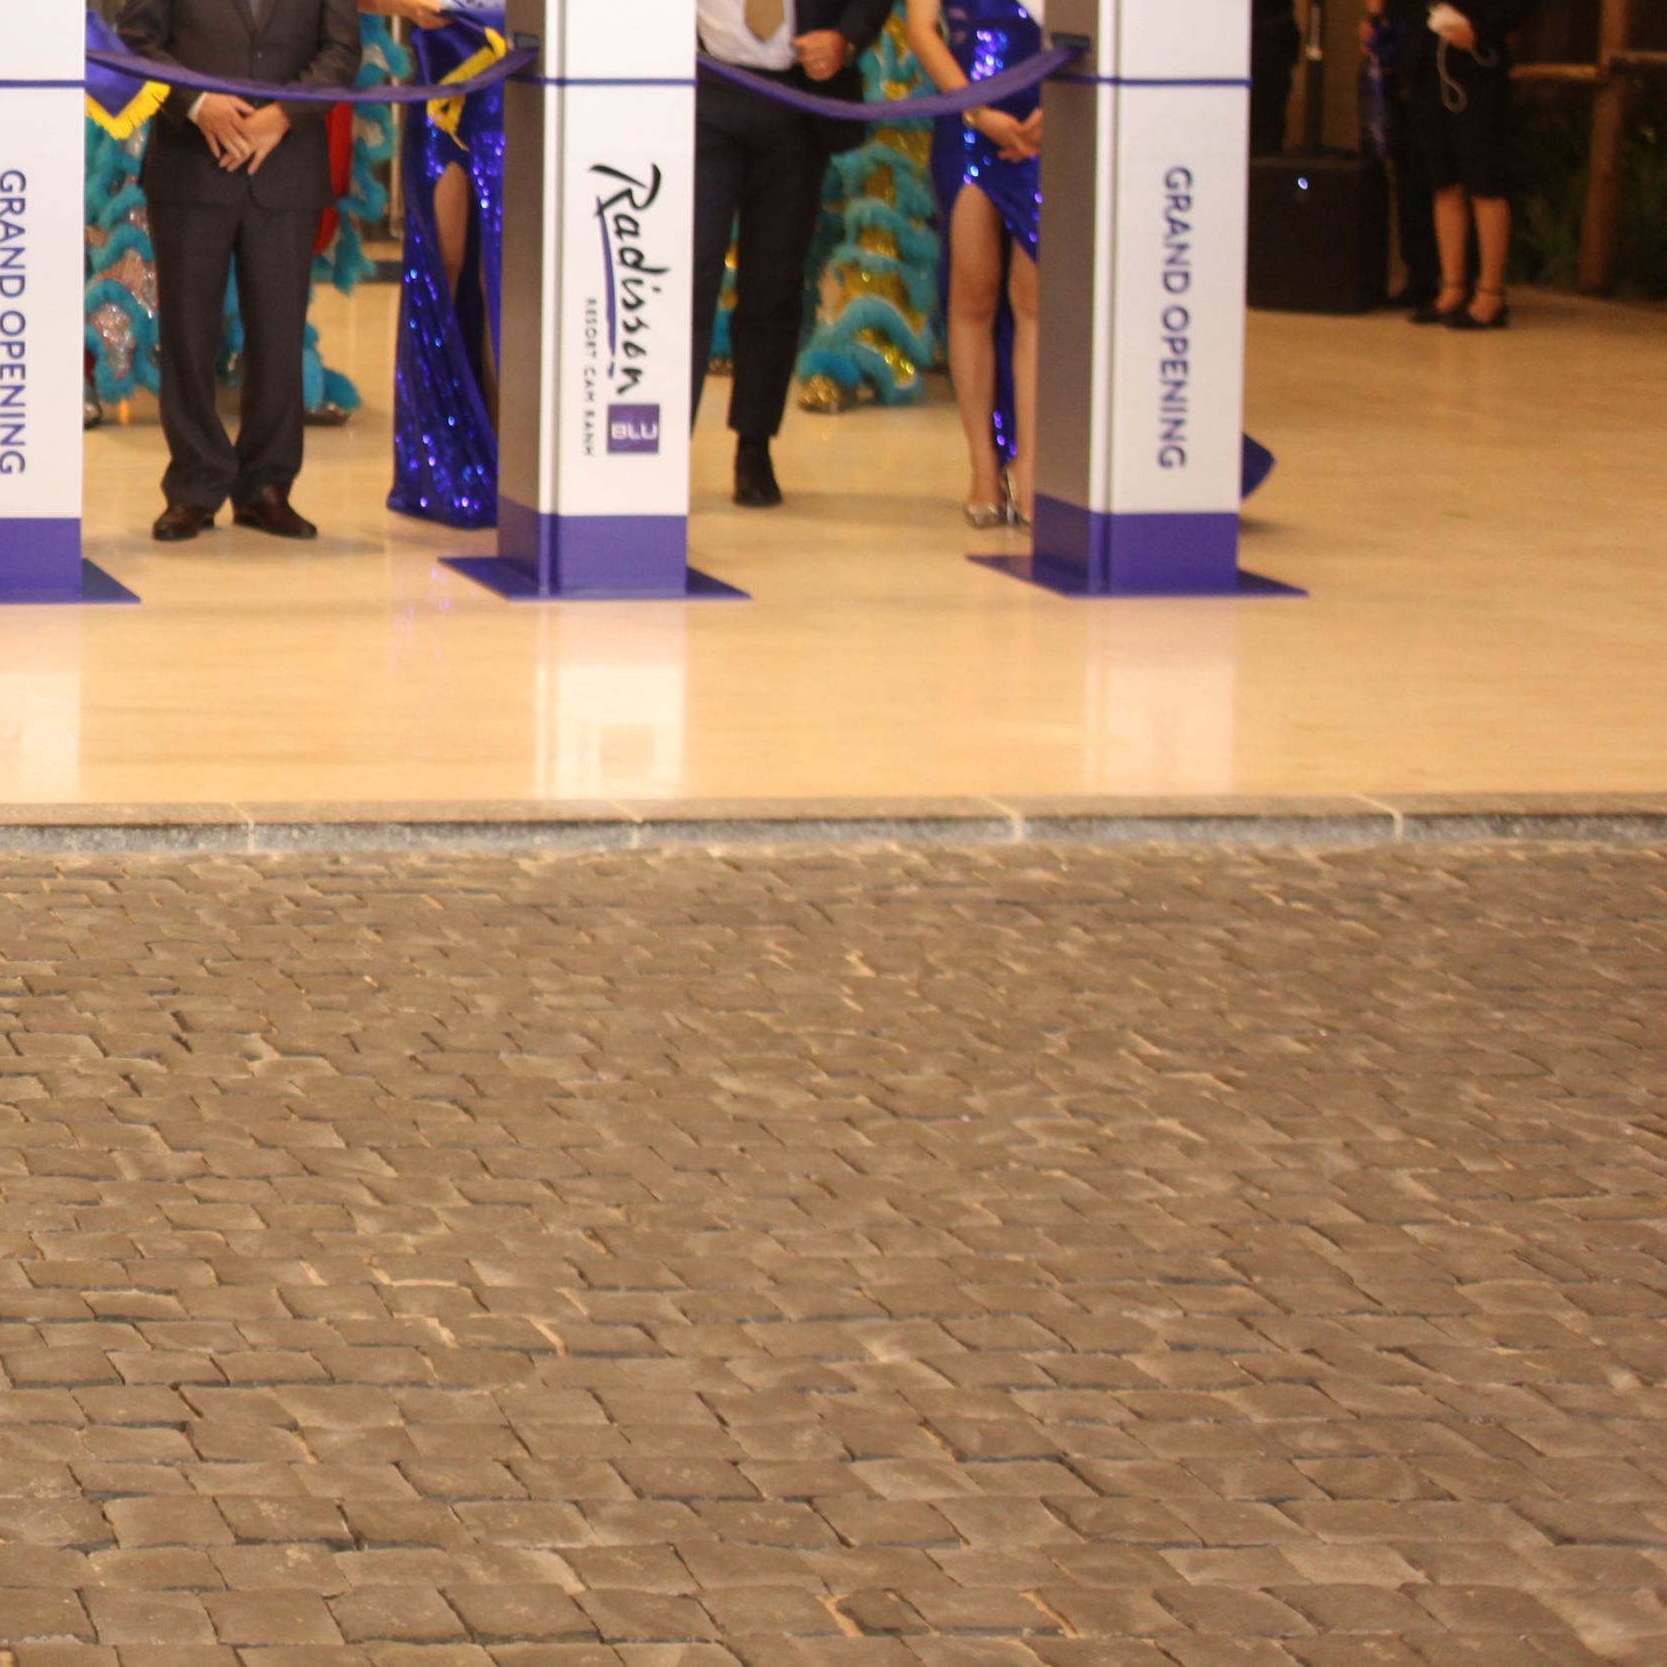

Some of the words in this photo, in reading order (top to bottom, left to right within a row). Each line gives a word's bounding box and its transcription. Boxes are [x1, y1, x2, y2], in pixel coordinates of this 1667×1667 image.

[588, 162, 671, 395] Radisson
[1162, 166, 1194, 295] GRAND
[610, 420, 658, 440] BLU
[1157, 305, 1190, 470] OPENING
